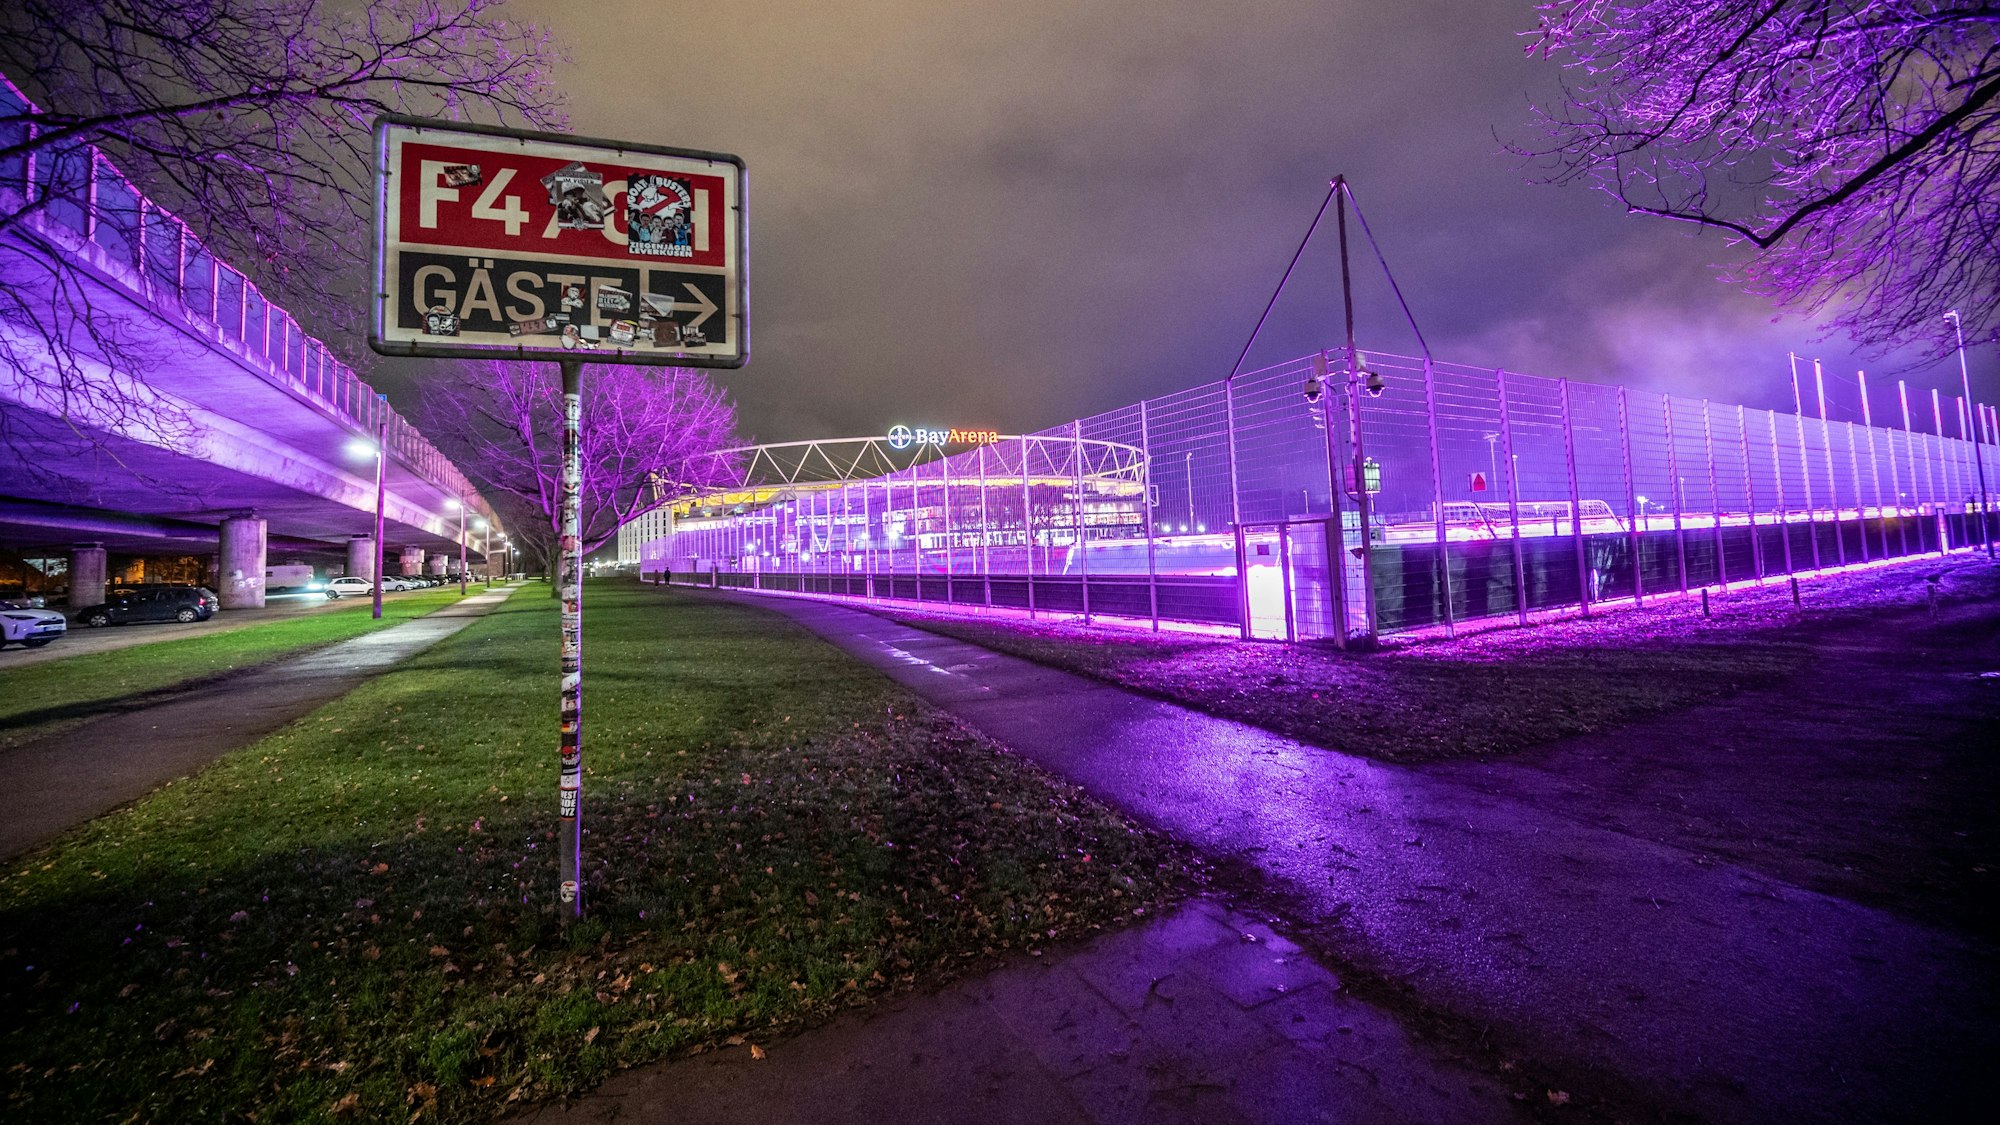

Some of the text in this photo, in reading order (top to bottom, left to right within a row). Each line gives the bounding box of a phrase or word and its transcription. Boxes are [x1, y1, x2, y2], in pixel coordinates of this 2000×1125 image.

[627, 179, 648, 203] GOAT
[629, 247, 693, 257] LEVERKUSEN
[412, 258, 624, 328] GÄSTE
[915, 428, 998, 446] BayArena
